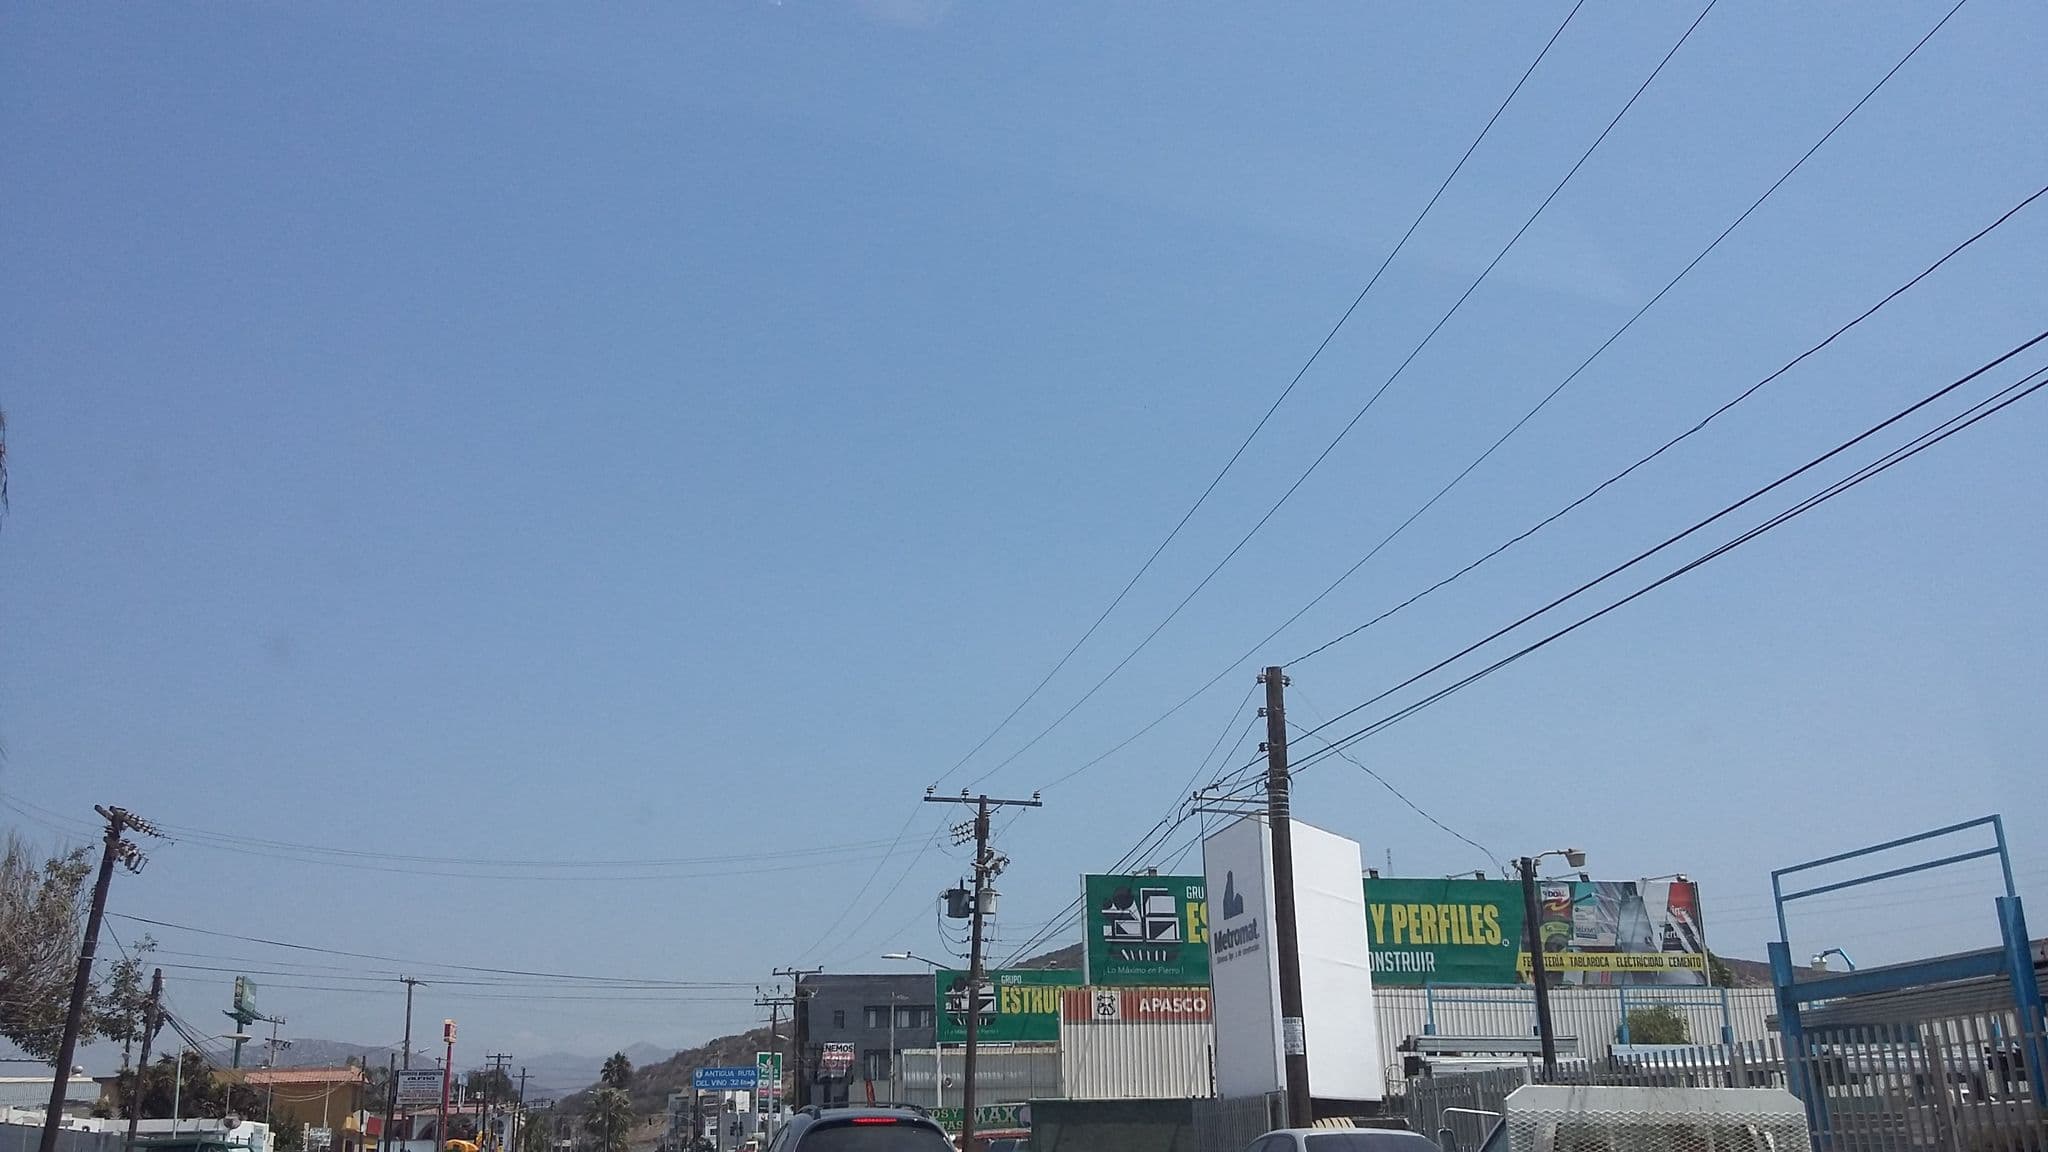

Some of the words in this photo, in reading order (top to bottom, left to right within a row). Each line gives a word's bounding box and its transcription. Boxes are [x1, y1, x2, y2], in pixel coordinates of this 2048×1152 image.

[1186, 885, 1204, 900] GRU
[1370, 903, 1385, 944] Y
[1391, 904, 1502, 946] PERFILES
[1569, 956, 1609, 967] TABLAROCA
[1668, 956, 1702, 968] CEMENTO
[1001, 975, 1022, 984] GRUPO
[1139, 997, 1206, 1013] APASCO
